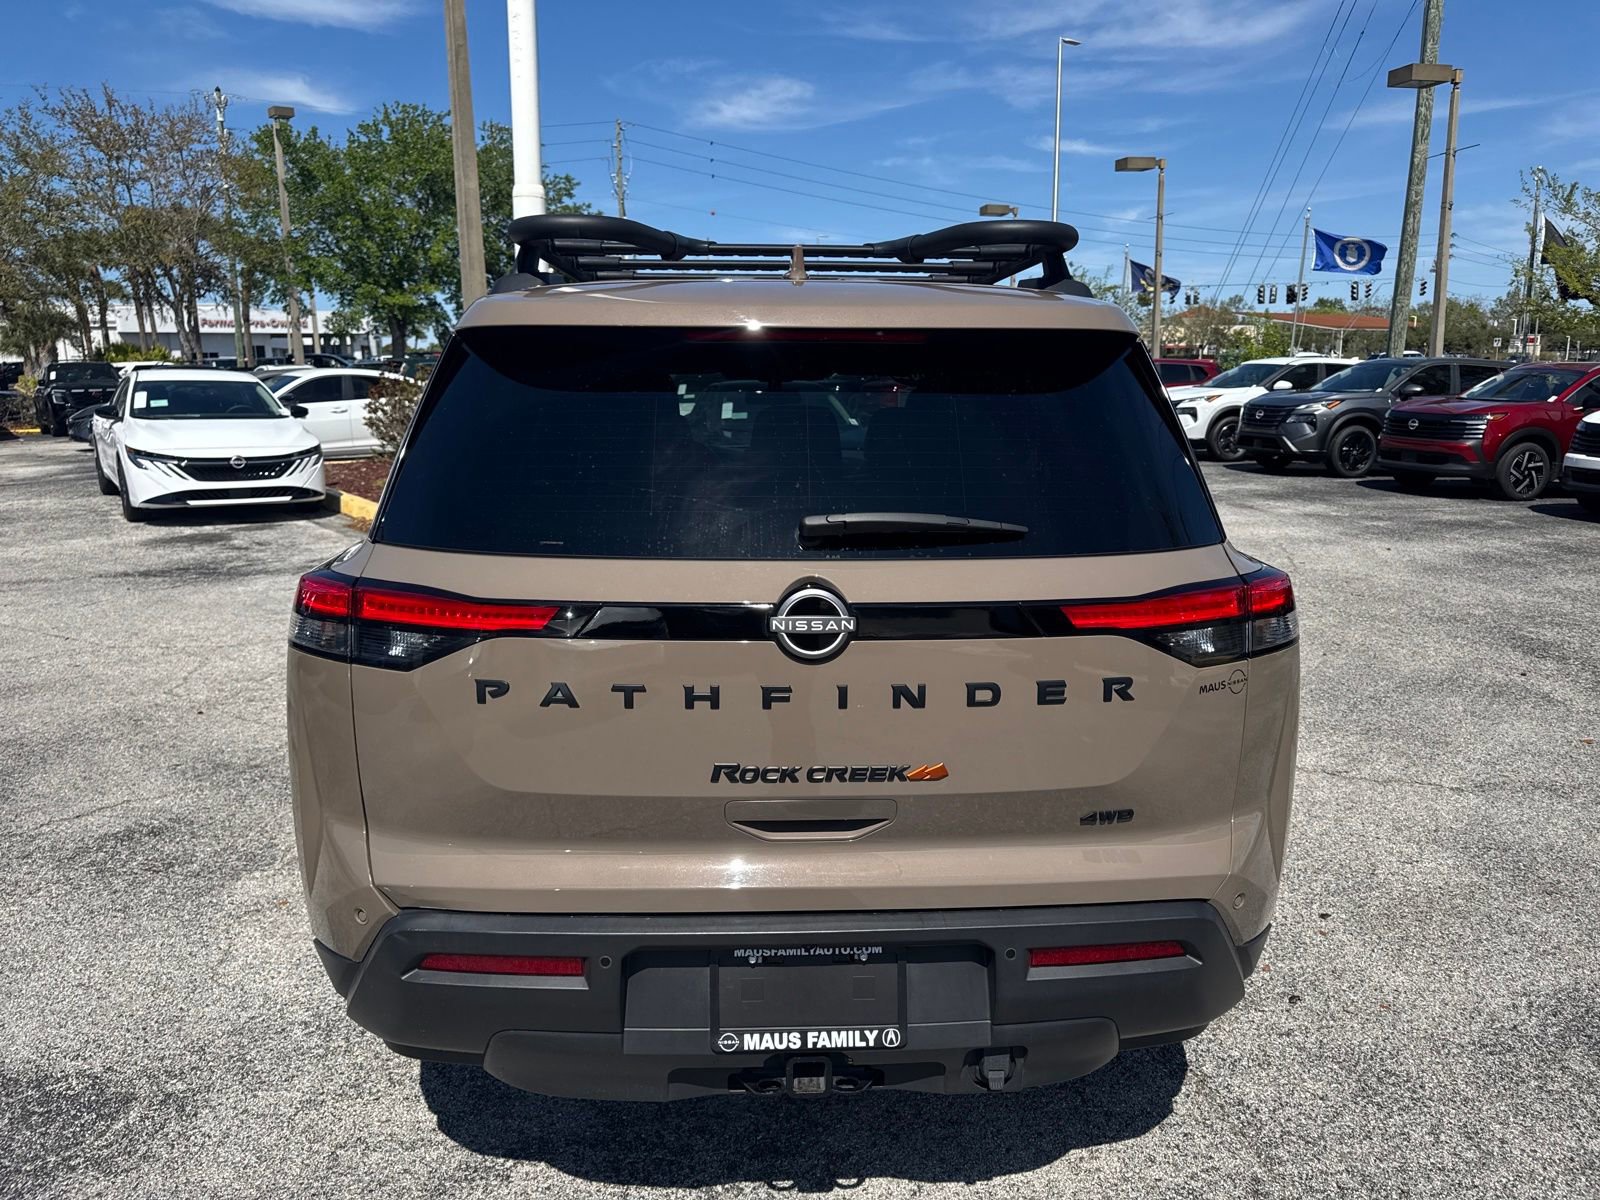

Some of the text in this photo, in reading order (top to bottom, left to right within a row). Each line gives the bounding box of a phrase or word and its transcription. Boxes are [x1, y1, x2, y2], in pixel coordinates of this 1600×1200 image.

[772, 619, 854, 631] NISSAN
[474, 676, 1135, 710] PATHFINDER
[1199, 680, 1227, 694] MAUS
[710, 762, 911, 784] ROCK CREEK
[1079, 808, 1135, 826] 4WD
[734, 946, 882, 957] MAUSFAMILYAUTO.COM
[743, 1030, 879, 1050] MAUS FAMILY
